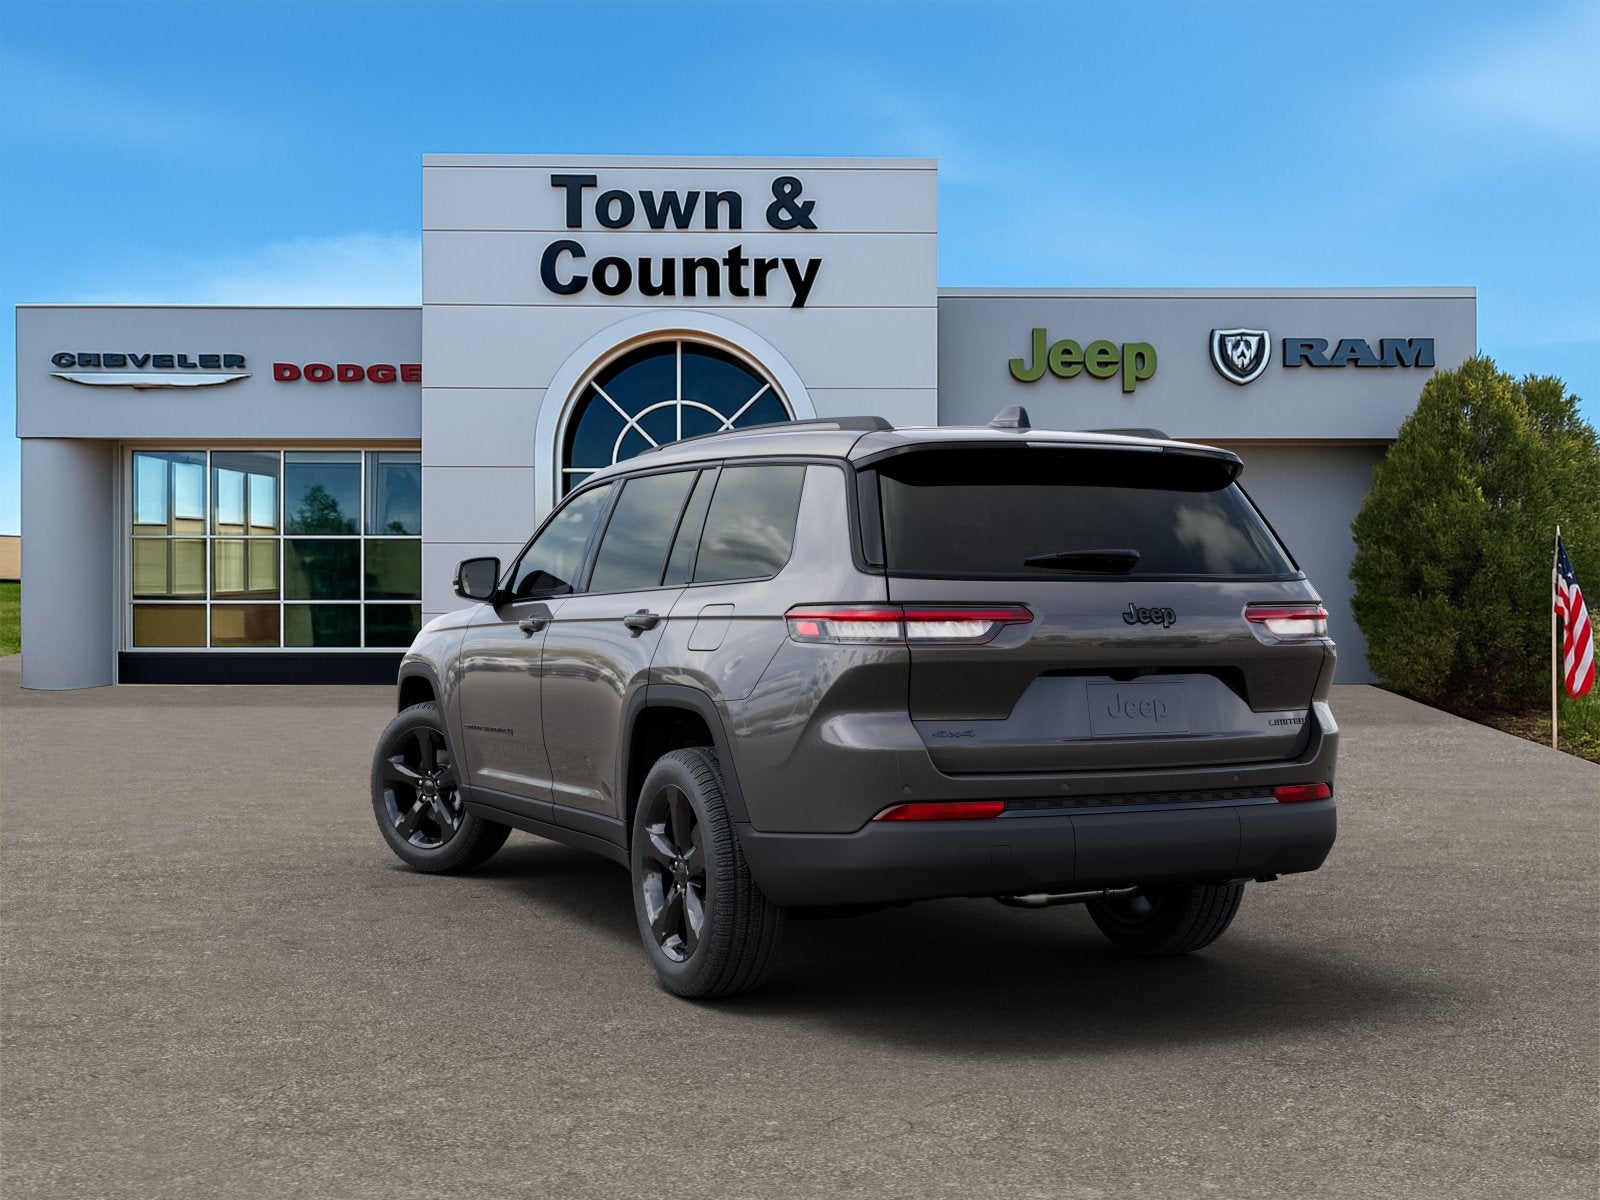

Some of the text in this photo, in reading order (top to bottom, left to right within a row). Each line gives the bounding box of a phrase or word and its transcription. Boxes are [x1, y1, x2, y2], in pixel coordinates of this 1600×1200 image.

[550, 174, 818, 230] Town &
[540, 239, 822, 308] Country
[1009, 328, 1157, 393] Jeep
[1282, 337, 1435, 368] RAM
[273, 363, 422, 383] DODGE
[1122, 603, 1177, 629] Jeep
[1107, 692, 1168, 723] Jeep
